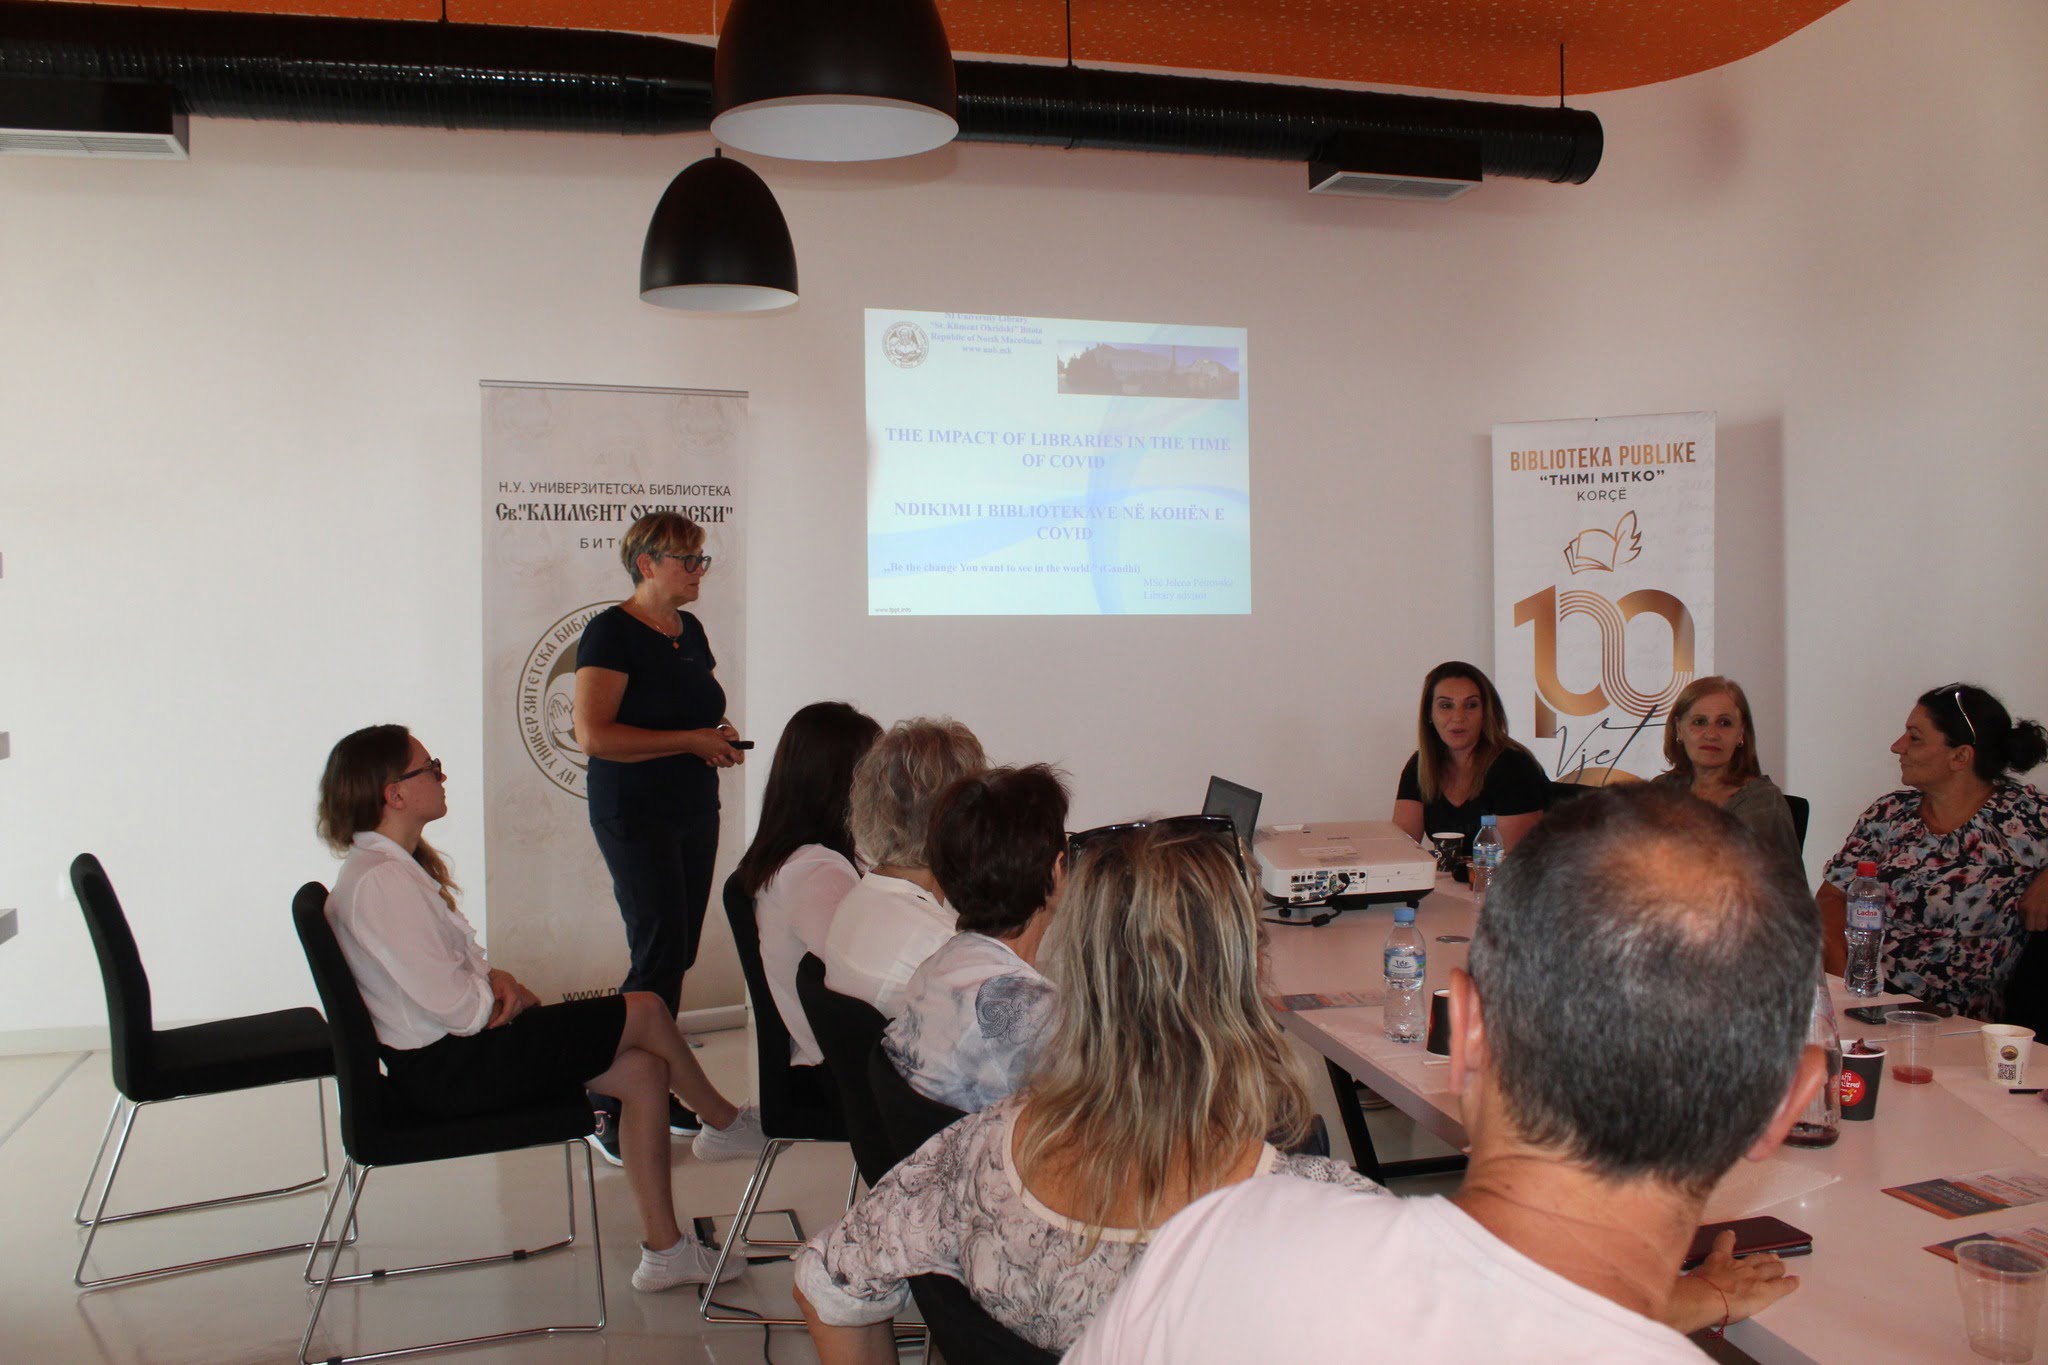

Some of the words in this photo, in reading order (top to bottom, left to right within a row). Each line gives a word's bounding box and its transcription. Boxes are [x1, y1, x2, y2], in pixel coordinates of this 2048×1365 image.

[930, 332, 965, 343] Republic
[966, 333, 975, 341] of
[977, 335, 999, 343] North
[1001, 336, 1042, 345] Macedonia
[885, 427, 923, 443] THE
[928, 429, 998, 446] IMPACT
[1002, 431, 1026, 446] OF
[1030, 432, 1123, 449] LIBRARIES
[1128, 435, 1146, 450] IN
[1150, 436, 1184, 451] THE
[1190, 437, 1231, 451] TIME
[1022, 453, 1046, 468] OF
[1050, 454, 1105, 469] COVID
[1510, 446, 1613, 472] BIBLIOTEKA
[1619, 441, 1696, 466] PUBLIKE
[499, 481, 526, 494] Н.У.
[530, 482, 645, 495] УНИВЕРЗИТЕТСКА
[649, 484, 731, 497] БИБЛИОТЕКА
[1577, 487, 1627, 503] KORÇË
[894, 501, 972, 517] NDIKIMI
[975, 503, 984, 518] I
[988, 504, 1118, 520] BIBLIOTEKAVE
[1122, 503, 1145, 520] NË
[1150, 503, 1210, 521] KOHËN
[1215, 507, 1225, 521] E
[1036, 526, 1093, 541] COVID
[579, 537, 620, 549] БИТ
[905, 562, 921, 573] the
[923, 562, 958, 575] change
[960, 562, 978, 573] You
[980, 564, 1003, 574] want
[1006, 564, 1016, 574] to
[1018, 565, 1032, 574] see
[1034, 563, 1044, 574] in
[1045, 563, 1061, 574] the
[1100, 563, 1141, 576] (Gandhi)
[1143, 590, 1175, 602] Library
[523, 641, 559, 770] УНИВЕРЗИТЕТСКА
[556, 767, 578, 786] НУ
[1856, 909, 1877, 917] Ladna
[562, 987, 616, 1003] www.n
